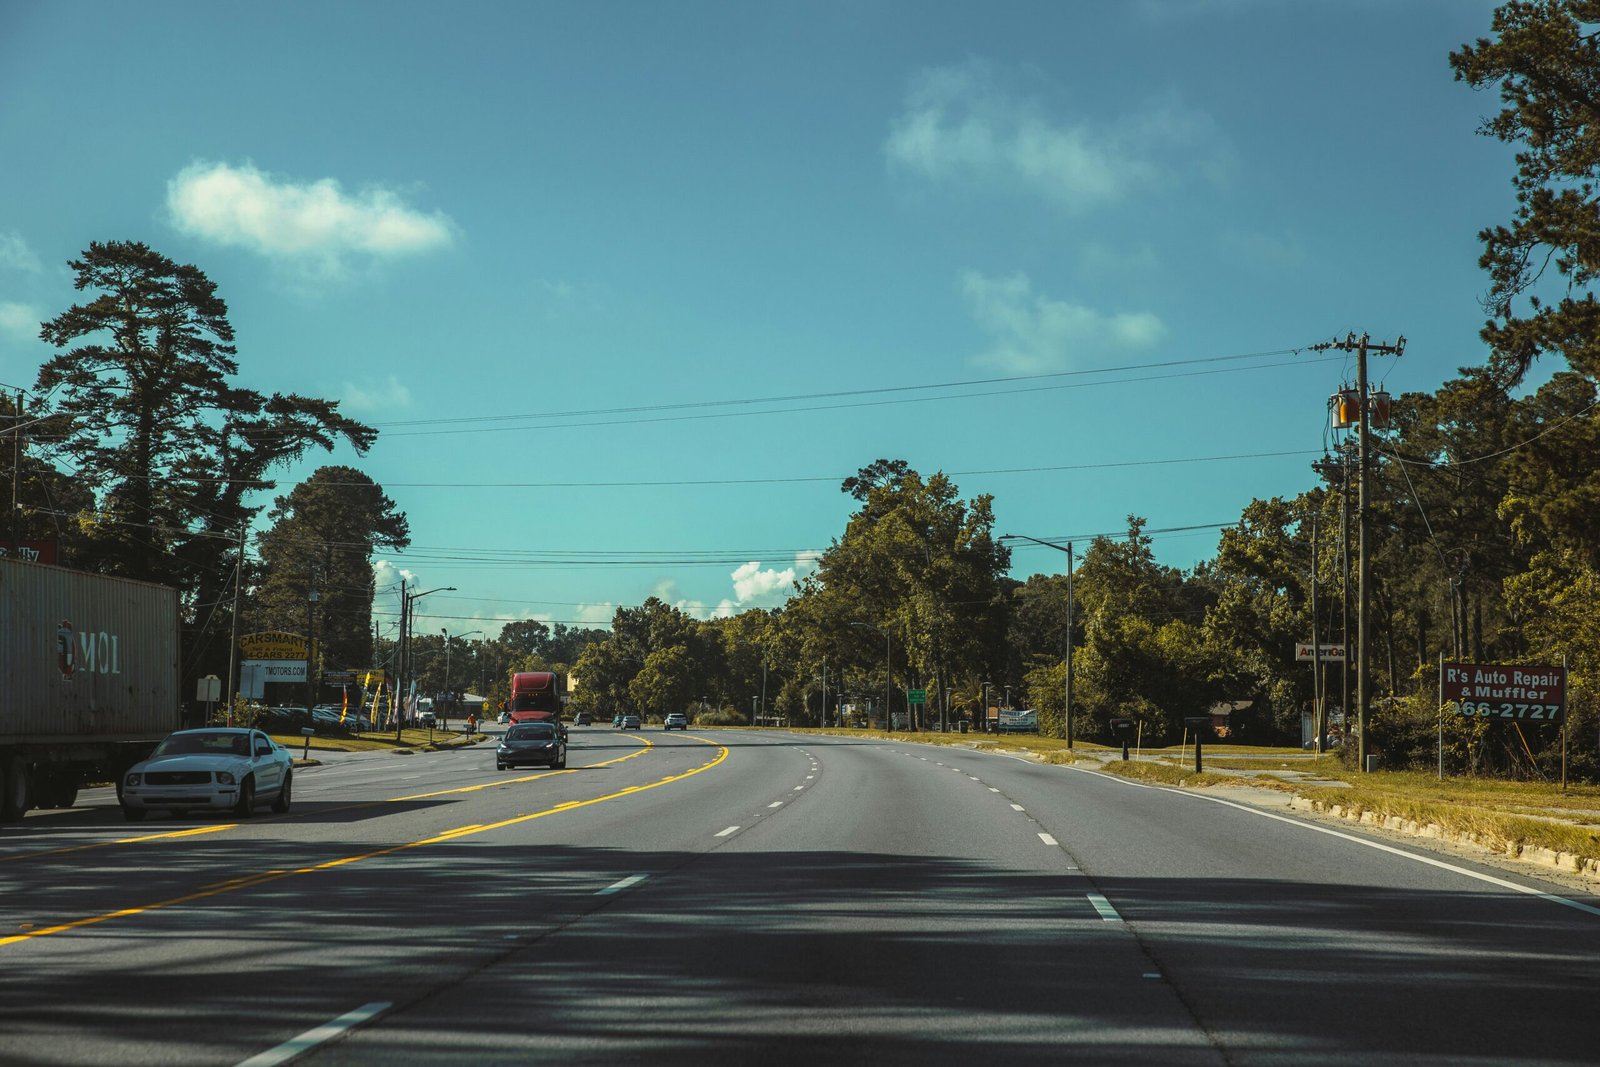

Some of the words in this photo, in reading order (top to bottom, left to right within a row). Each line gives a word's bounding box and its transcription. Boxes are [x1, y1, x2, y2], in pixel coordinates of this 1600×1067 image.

[79, 631, 121, 674] MOL
[1300, 647, 1345, 657] AmeriGa
[1447, 668, 1469, 683] R's
[1474, 669, 1507, 684] Auto
[1514, 670, 1560, 688] Repair
[1461, 686, 1472, 697] &
[1475, 686, 1548, 700] Muffler
